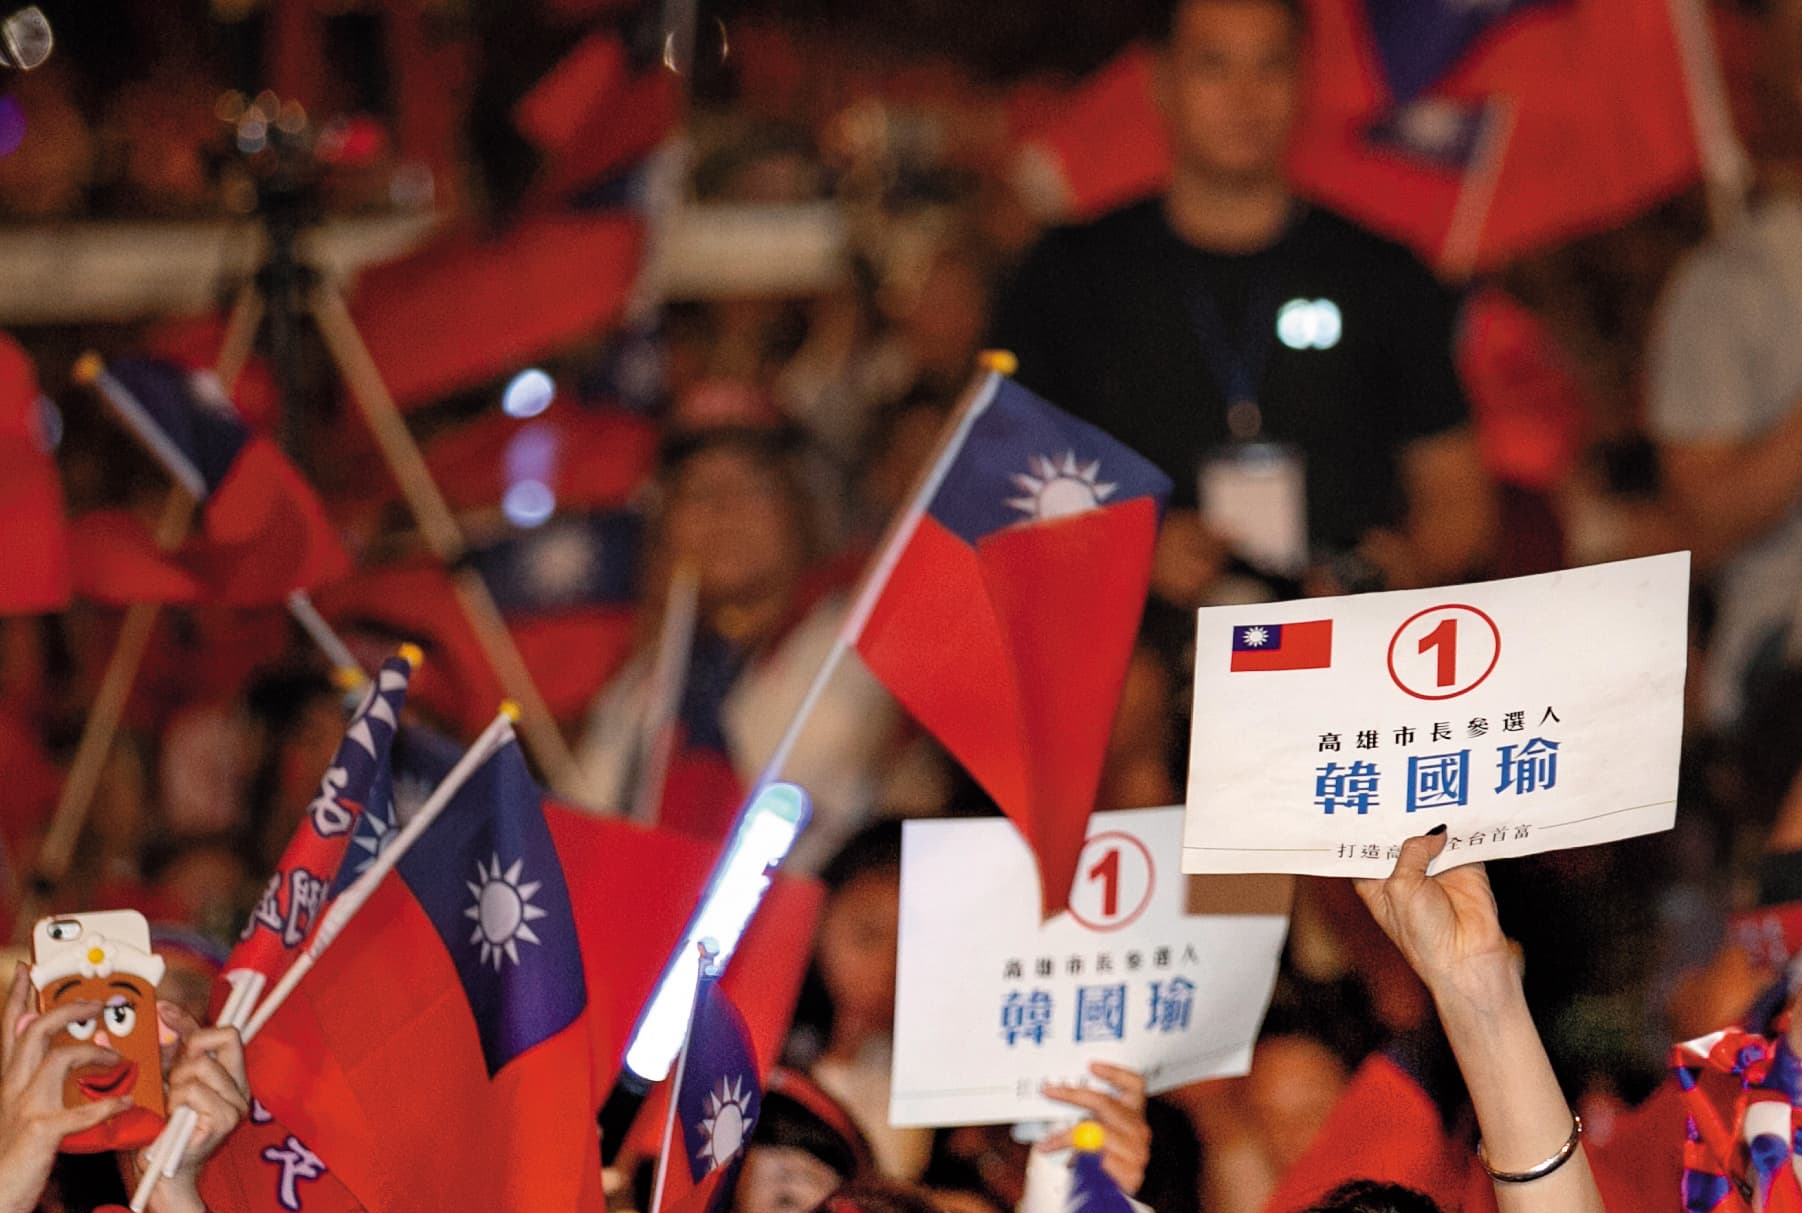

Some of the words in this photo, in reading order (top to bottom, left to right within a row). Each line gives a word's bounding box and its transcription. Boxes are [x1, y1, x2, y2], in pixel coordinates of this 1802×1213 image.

[1418, 618, 1458, 688] 1
[1317, 705, 1562, 753] 高雄市長參選人
[1313, 737, 1563, 815] 韓國瑜
[1087, 847, 1121, 917] 1
[999, 975, 1197, 1046] 韓國瑜
